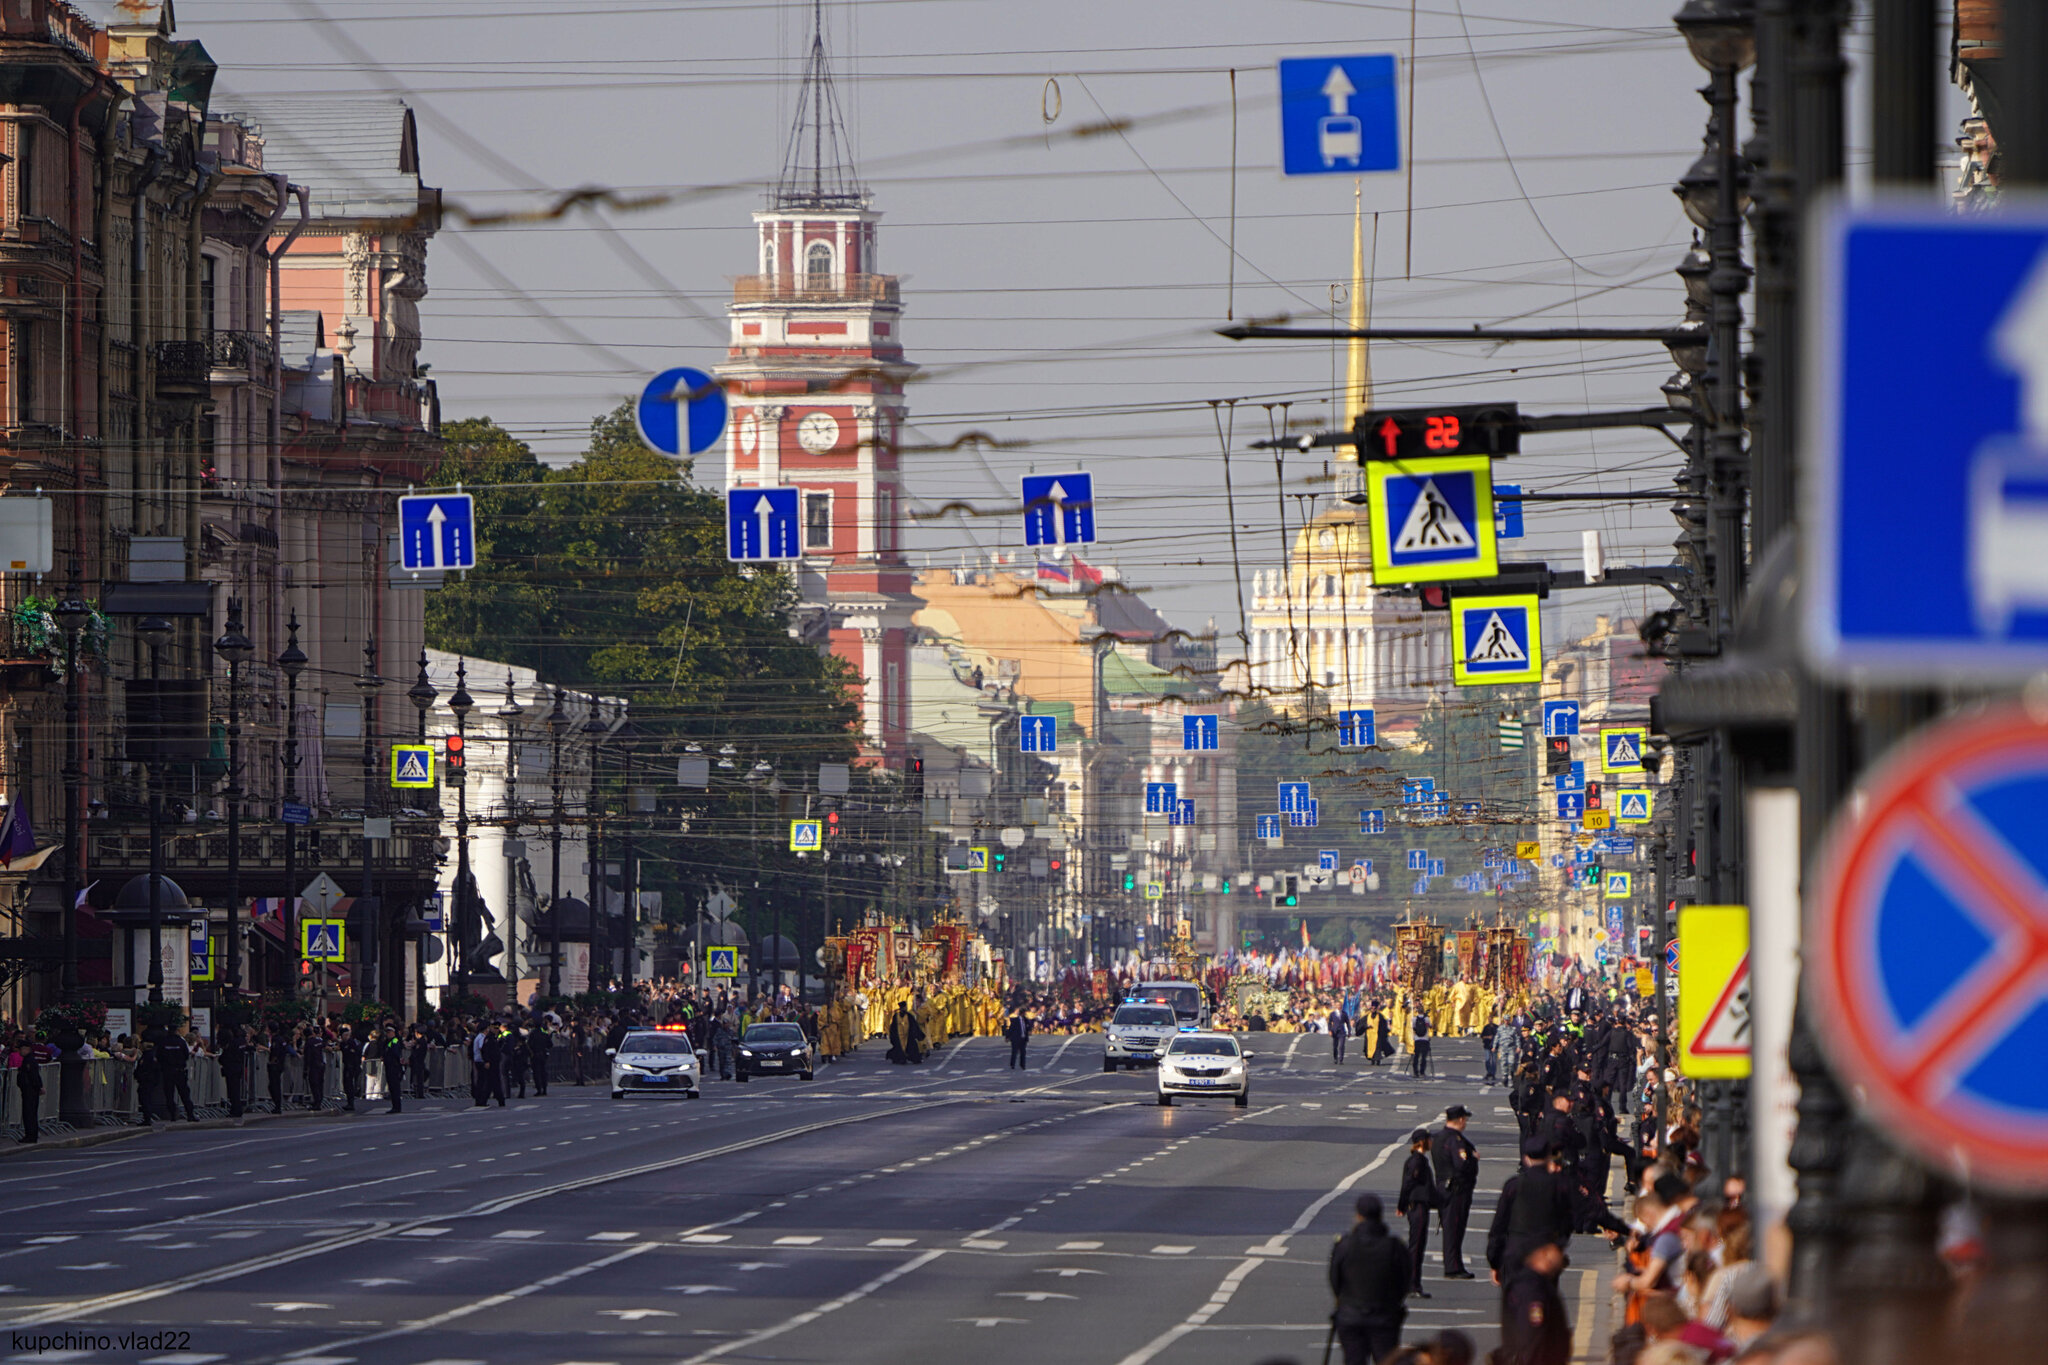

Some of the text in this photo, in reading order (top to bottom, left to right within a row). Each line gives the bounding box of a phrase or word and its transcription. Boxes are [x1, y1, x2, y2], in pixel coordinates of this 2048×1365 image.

[1425, 416, 1459, 450] 22
[1554, 740, 1568, 753] 41
[450, 755, 463, 767] 41
[1591, 816, 1603, 826] 10
[1524, 846, 1534, 855] 10
